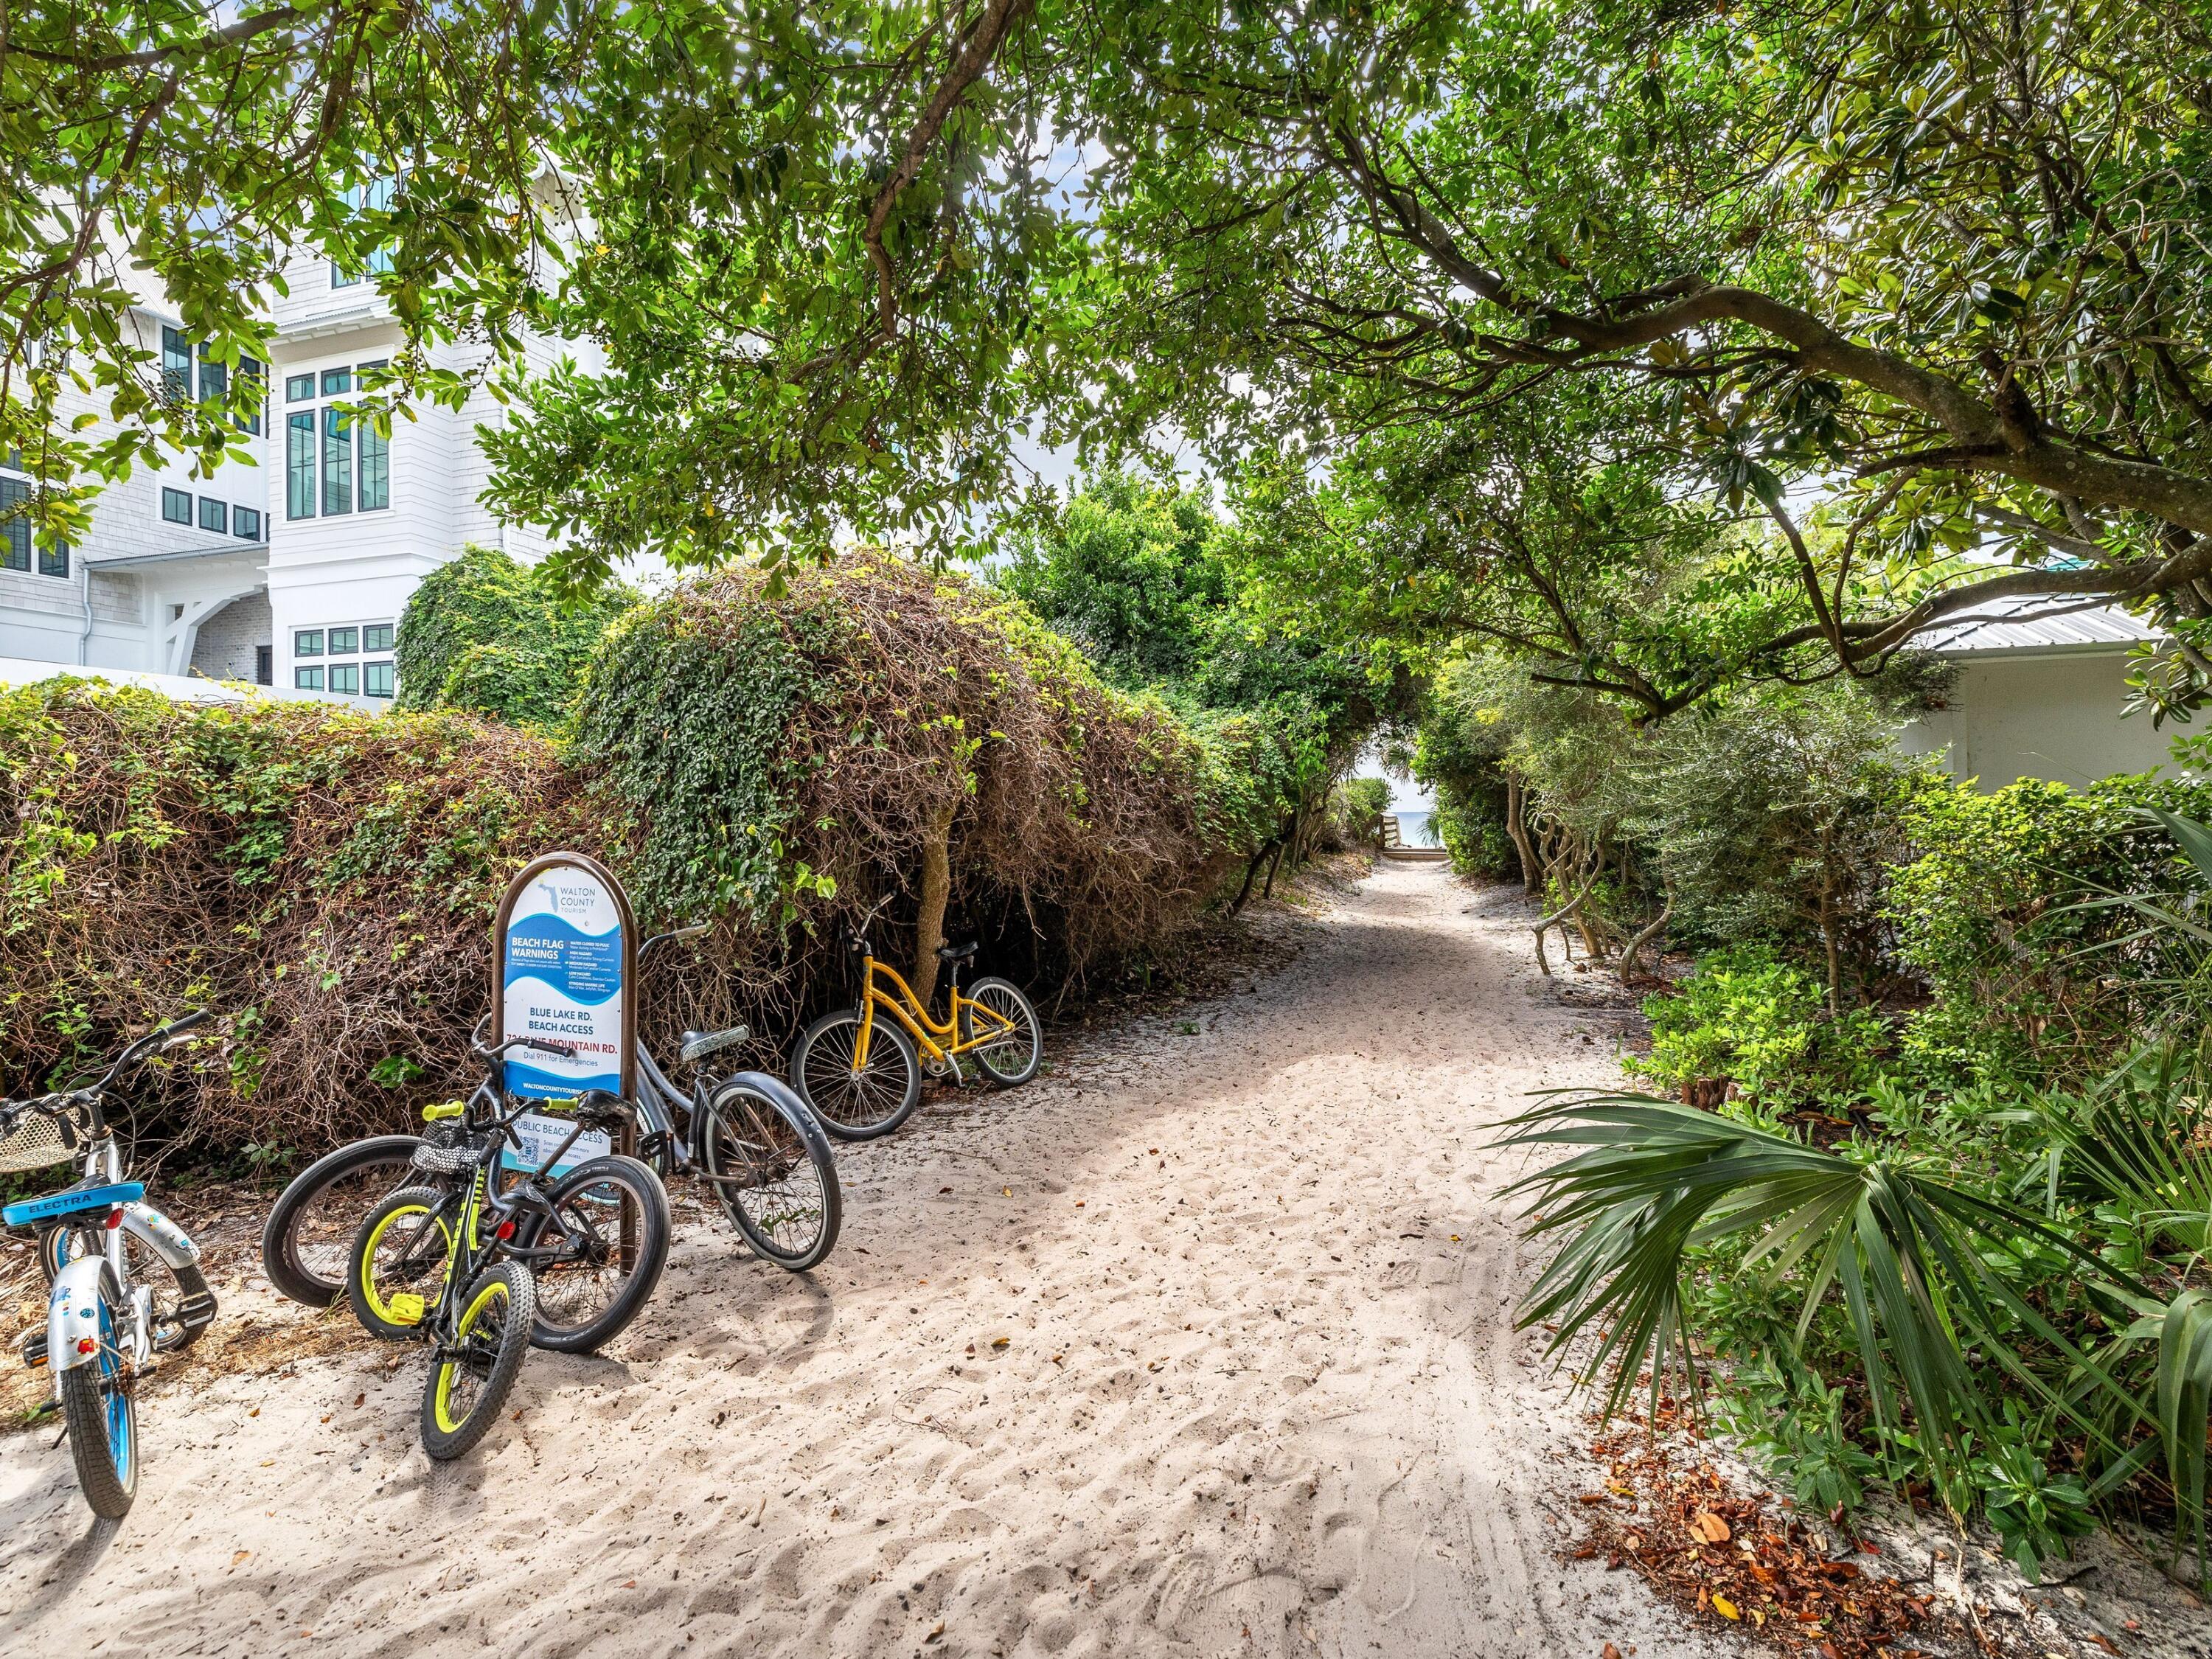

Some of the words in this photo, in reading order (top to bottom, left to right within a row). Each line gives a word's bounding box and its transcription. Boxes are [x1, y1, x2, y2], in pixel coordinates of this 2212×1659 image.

[560, 887, 596, 897] WALTON
[560, 897, 595, 907] COUNTY
[512, 936, 540, 948] BEACH
[542, 939, 564, 950] FLAG
[511, 947, 559, 959] WARNINGS
[530, 1007, 551, 1018] BLUE
[553, 1009, 575, 1020] LAKE
[577, 1012, 592, 1021] RD.
[529, 1020, 557, 1032] BEACH
[559, 1024, 594, 1035] ACCESS
[549, 1038, 599, 1052] MOUNTAIN
[602, 1044, 618, 1054] RD.
[536, 1052, 547, 1061] 911
[549, 1054, 557, 1062] for
[559, 1056, 598, 1067] Emergencies
[512, 1120, 541, 1133] PUBLIC
[543, 1124, 570, 1137] BEACH
[577, 1132, 602, 1144] CESS
[29, 1194, 92, 1214] ELECTRA
